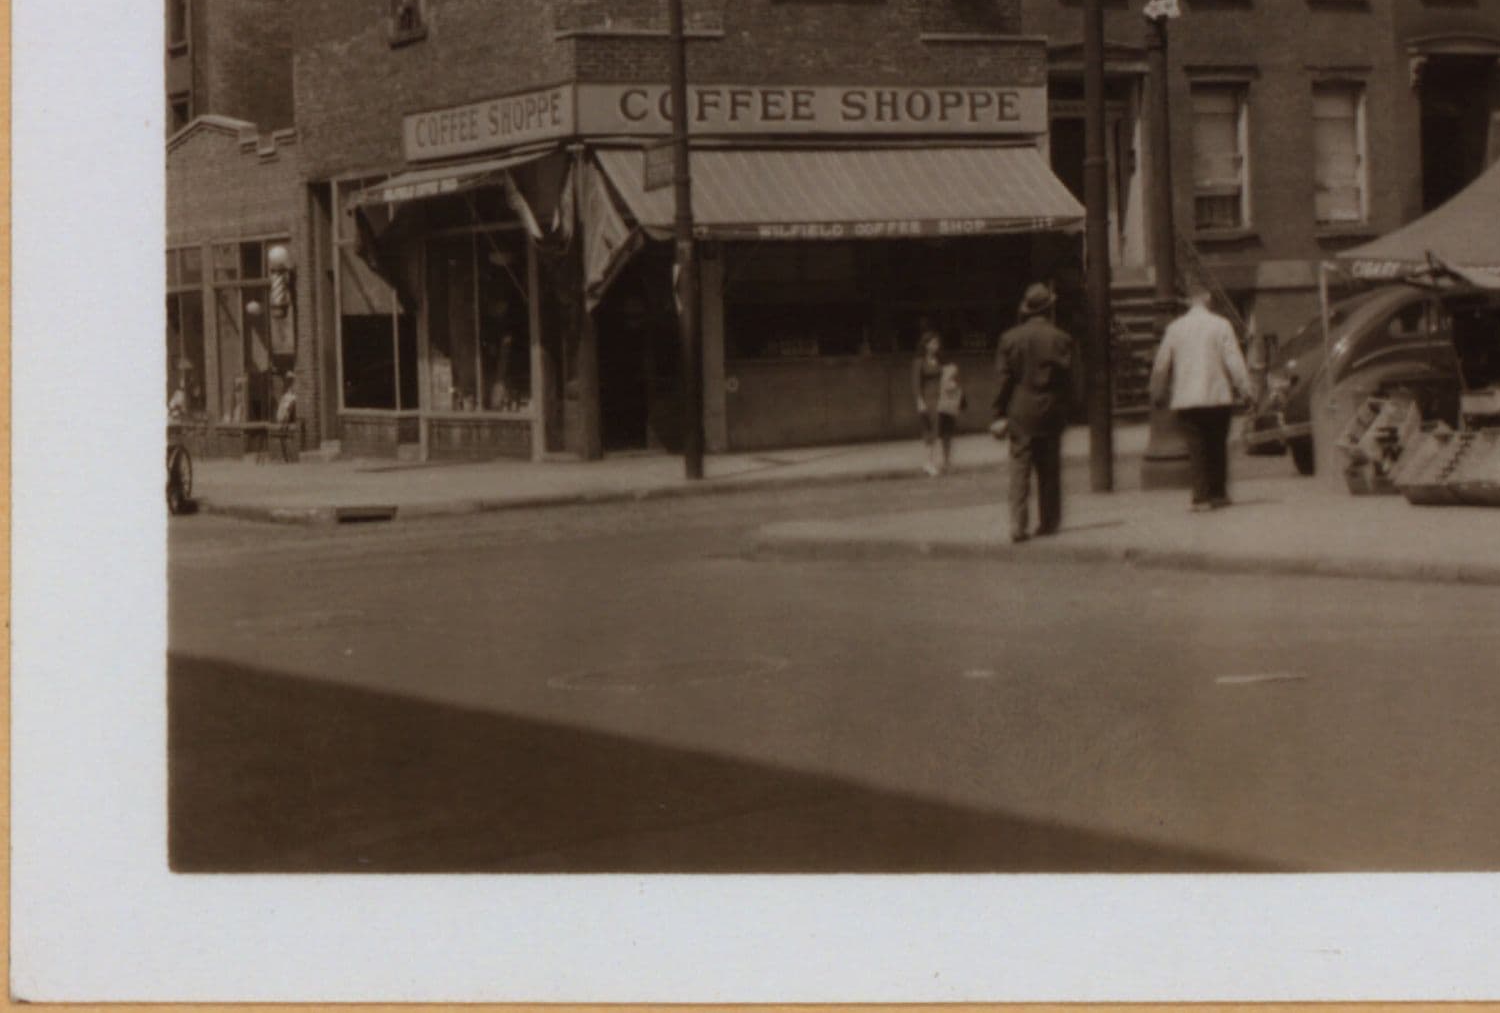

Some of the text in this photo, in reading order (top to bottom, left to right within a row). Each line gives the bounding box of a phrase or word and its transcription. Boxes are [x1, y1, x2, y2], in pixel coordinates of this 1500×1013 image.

[414, 91, 562, 148] COFFEE SHOPPE
[619, 88, 1022, 123] COFFEE SHOPPE
[853, 221, 921, 236] COFFEE
[936, 219, 986, 235] SHOP
